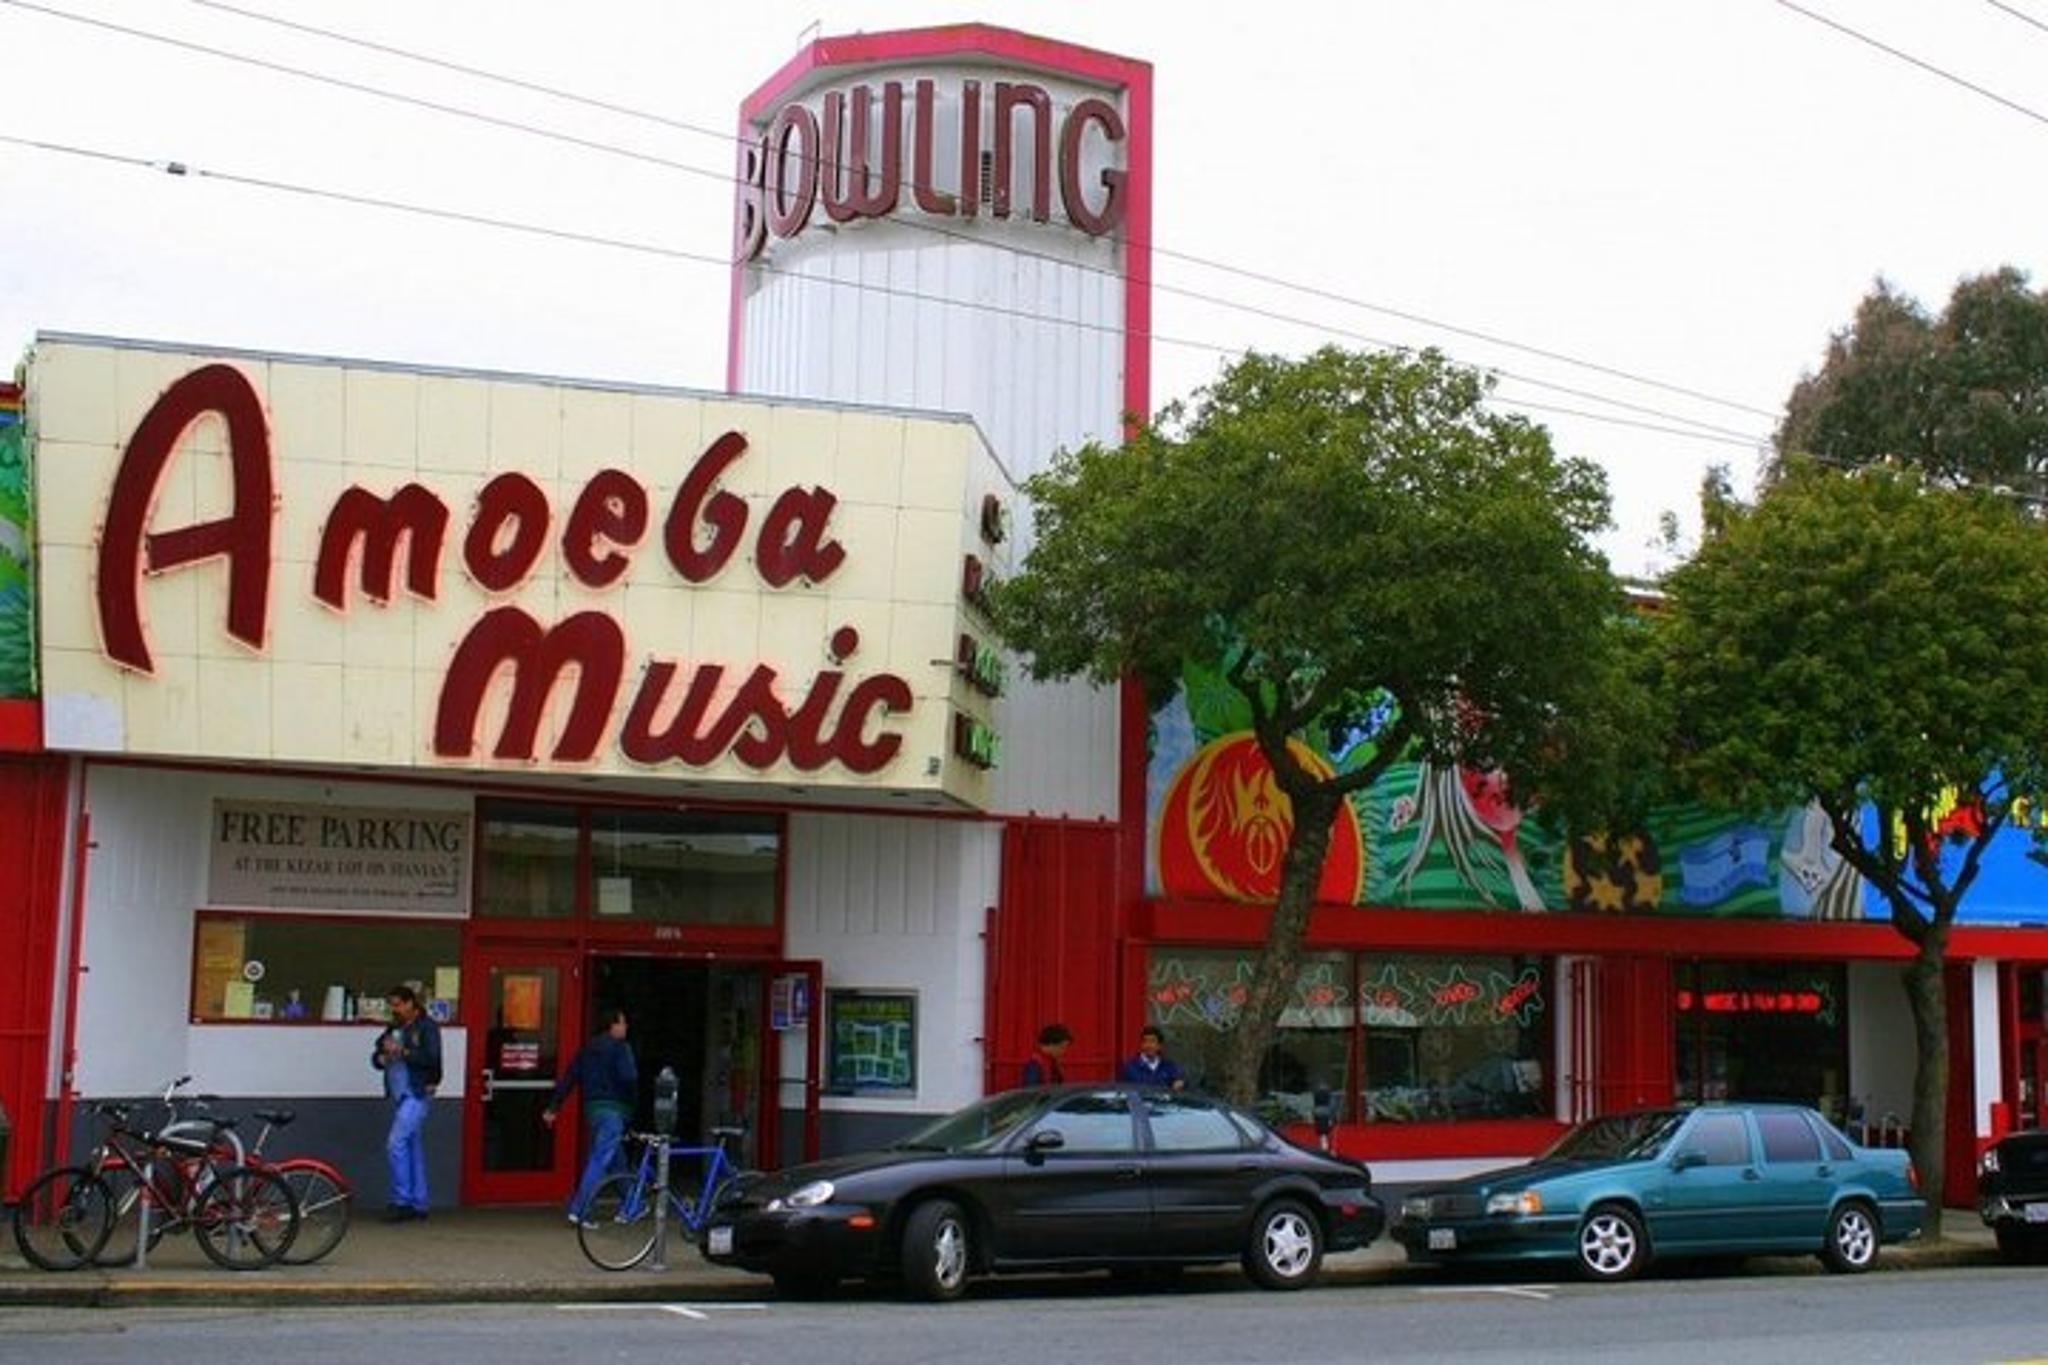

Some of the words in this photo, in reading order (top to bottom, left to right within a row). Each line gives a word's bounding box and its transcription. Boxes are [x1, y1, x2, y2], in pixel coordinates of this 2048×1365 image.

[97, 363, 847, 673] Amoeba
[434, 605, 915, 775] Music
[220, 811, 306, 845] FREE
[320, 815, 461, 853] PARKING
